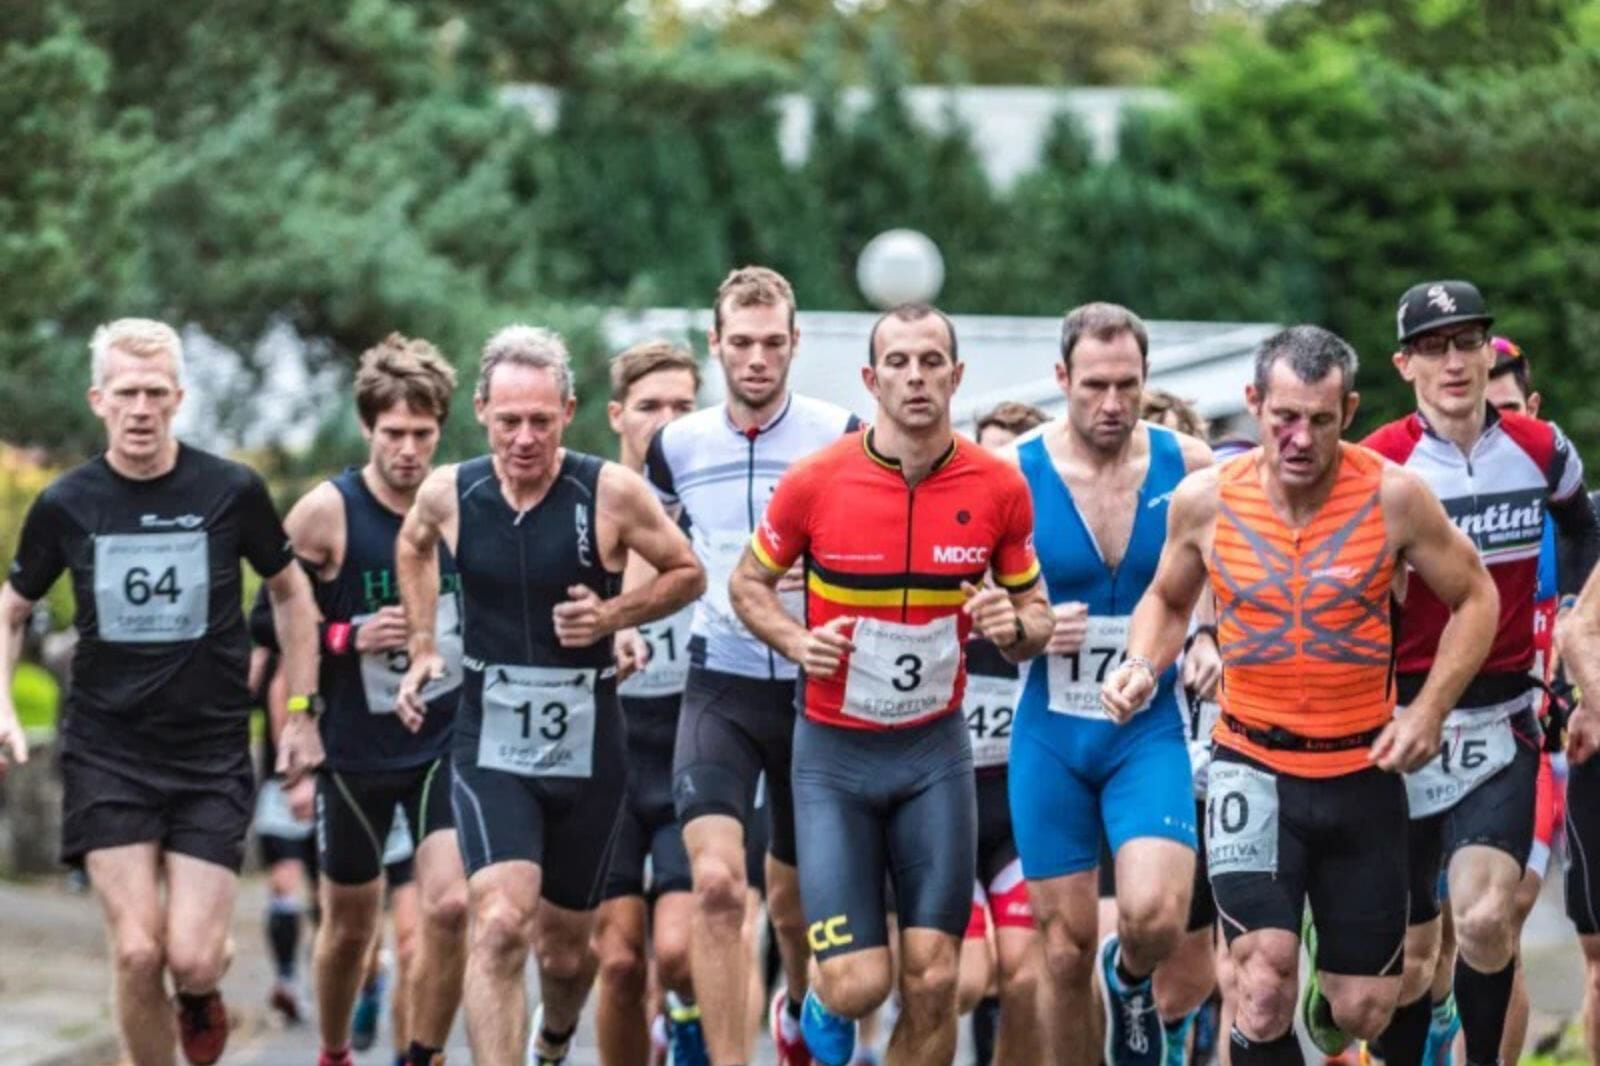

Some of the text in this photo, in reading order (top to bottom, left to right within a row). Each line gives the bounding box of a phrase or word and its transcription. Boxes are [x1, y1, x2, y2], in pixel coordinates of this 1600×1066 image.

[1450, 498, 1543, 534] ntini
[932, 545, 988, 563] MDCC
[124, 565, 183, 606] 64
[891, 653, 922, 692] 3
[1062, 647, 1127, 682] 17
[513, 701, 568, 741] 13
[967, 705, 1014, 738] 42
[1441, 739, 1488, 774] 15
[1207, 790, 1249, 834] 10
